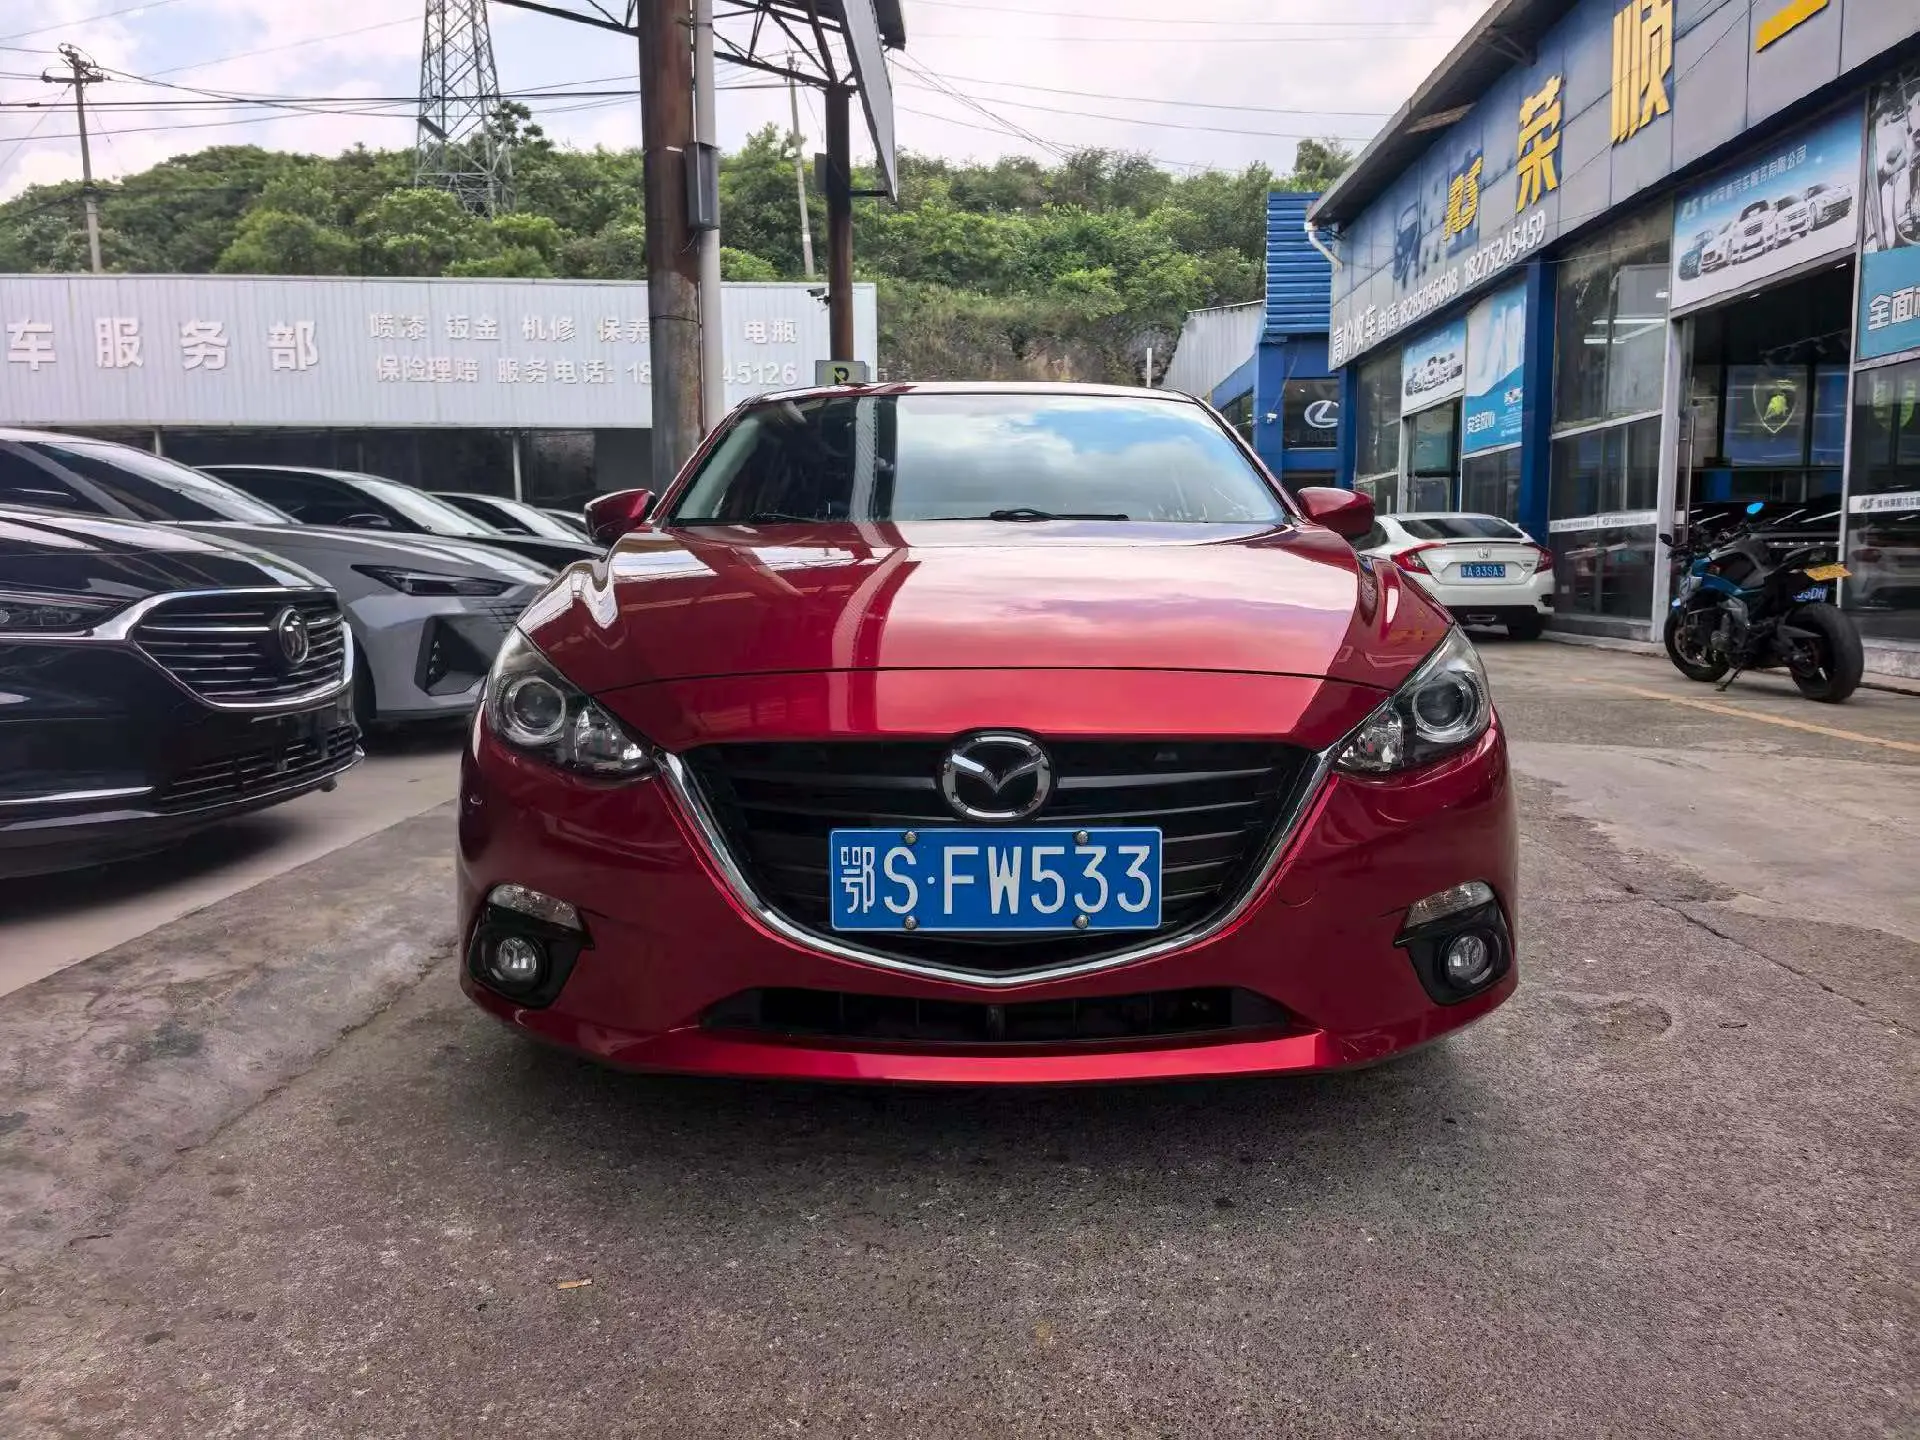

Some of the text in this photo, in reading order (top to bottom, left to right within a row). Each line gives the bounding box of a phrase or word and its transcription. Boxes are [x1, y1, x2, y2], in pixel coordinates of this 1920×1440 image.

[368, 313, 798, 345] 喷漆 钣金 机修 保养 电瓶
[1868, 285, 1920, 332] 全面
[7, 316, 319, 371] 车服务部
[375, 356, 480, 385] 保险理赔
[839, 845, 1152, 915] 鄂S·FW533
